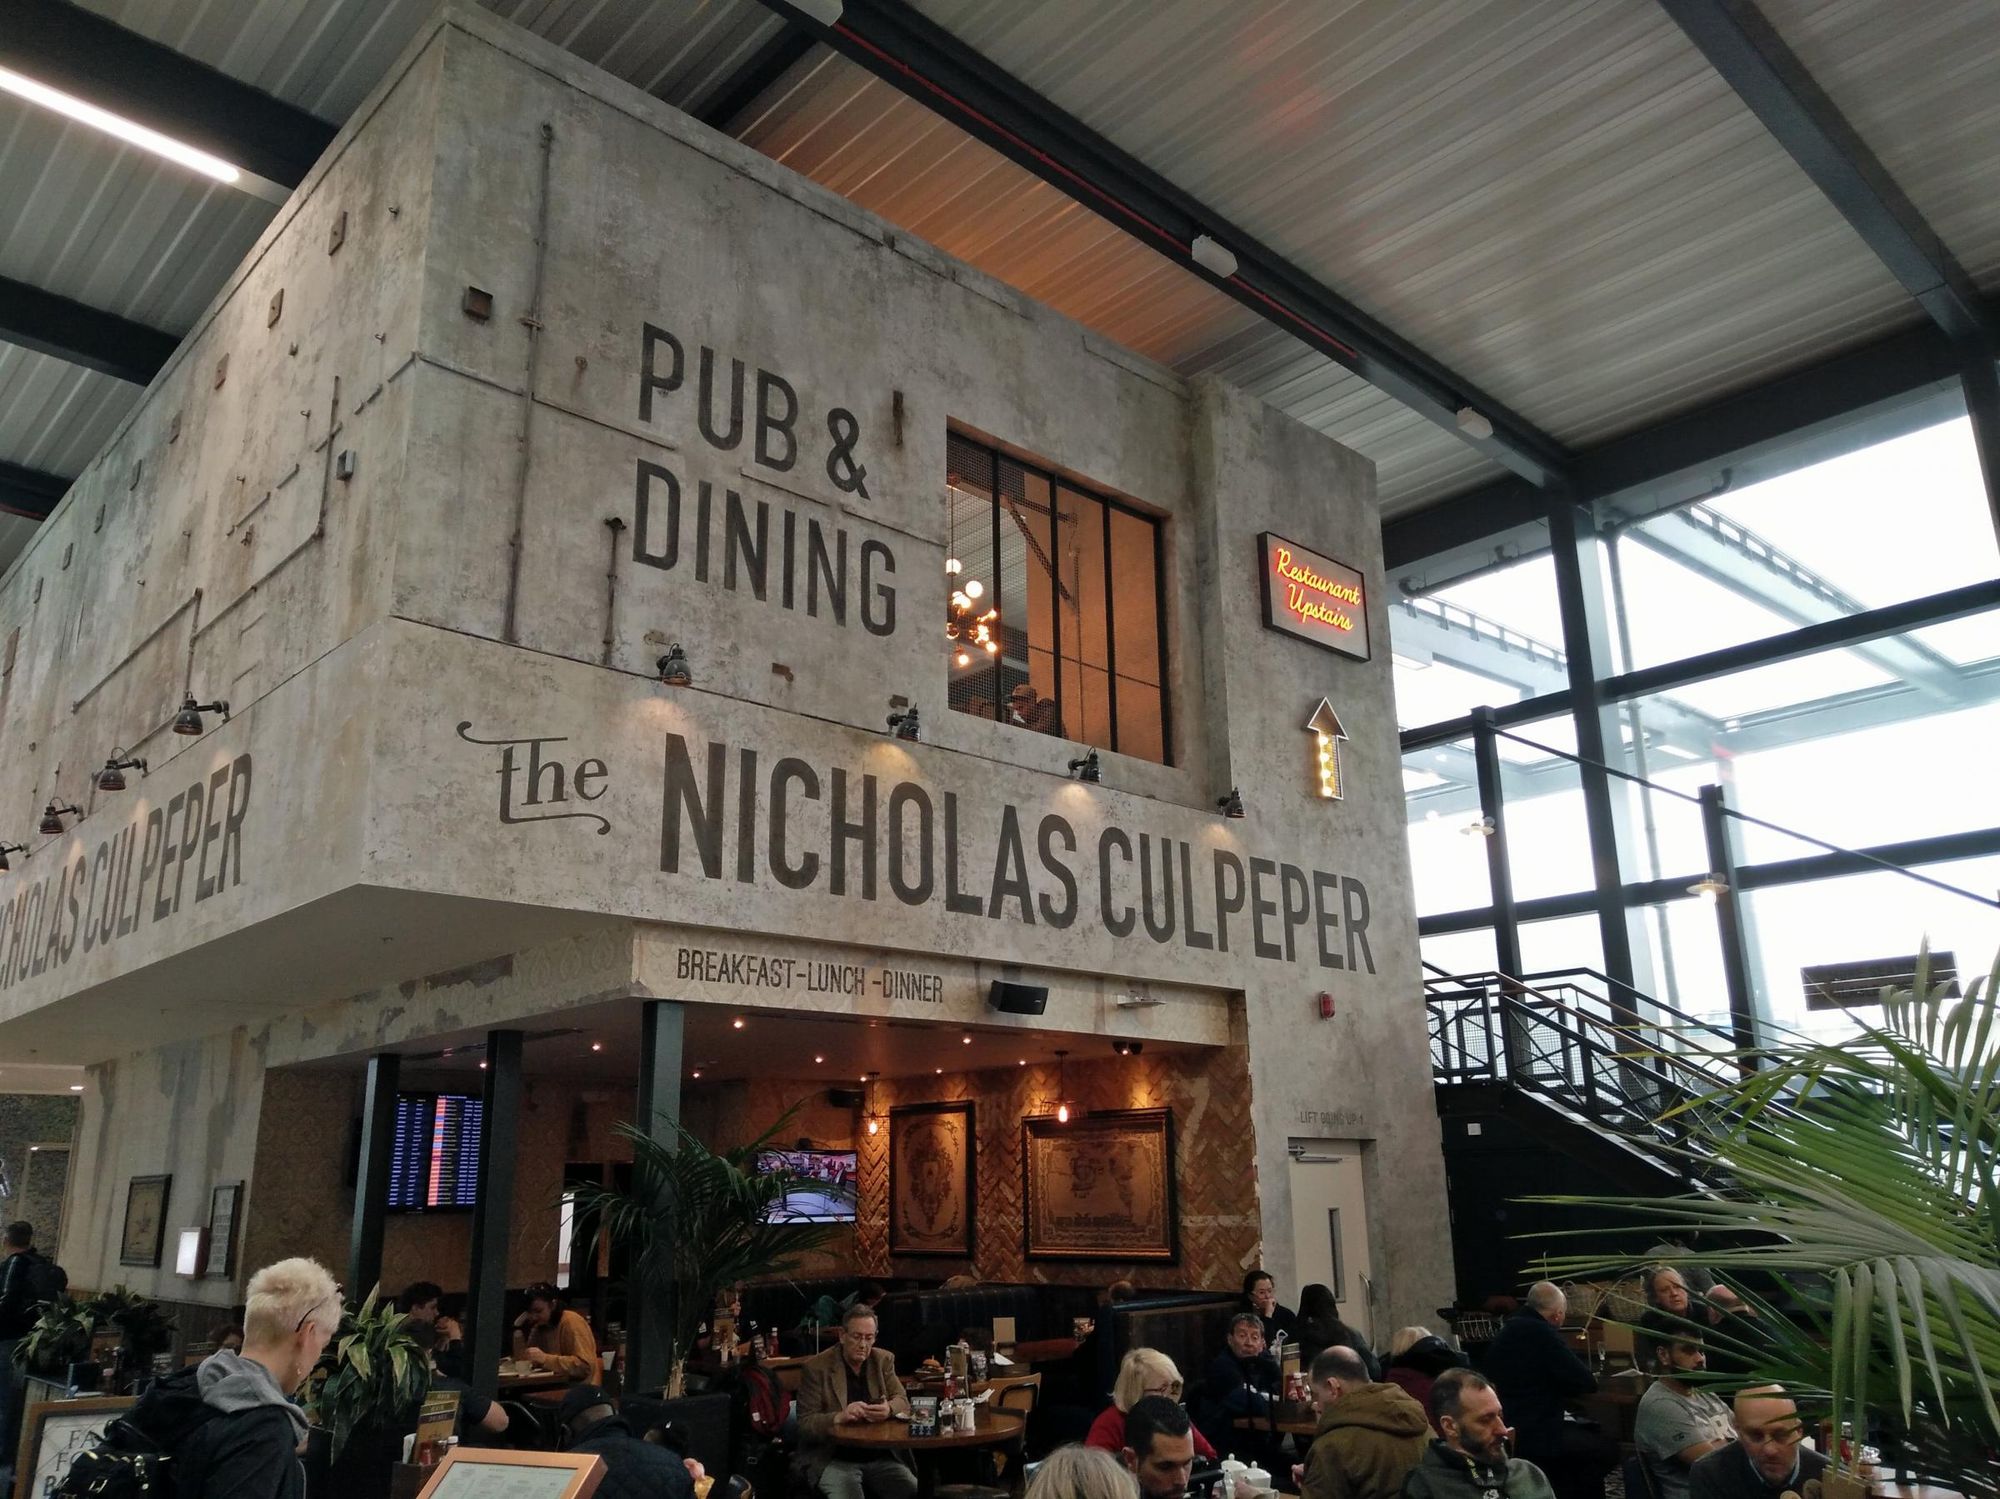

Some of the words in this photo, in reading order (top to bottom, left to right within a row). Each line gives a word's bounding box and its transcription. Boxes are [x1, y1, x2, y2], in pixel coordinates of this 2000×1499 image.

[638, 321, 798, 473] PUB
[826, 407, 871, 501] &
[632, 457, 896, 636] DINING
[1276, 548, 1361, 605] Restaurant
[1288, 583, 1354, 631] Upstairs
[0, 855, 86, 990] CHOLAS
[83, 753, 252, 953] CULPEPER
[660, 732, 1078, 929] NICHOLAS
[1098, 826, 1376, 975] CULPEPER
[1300, 1111, 1318, 1124] LIFT
